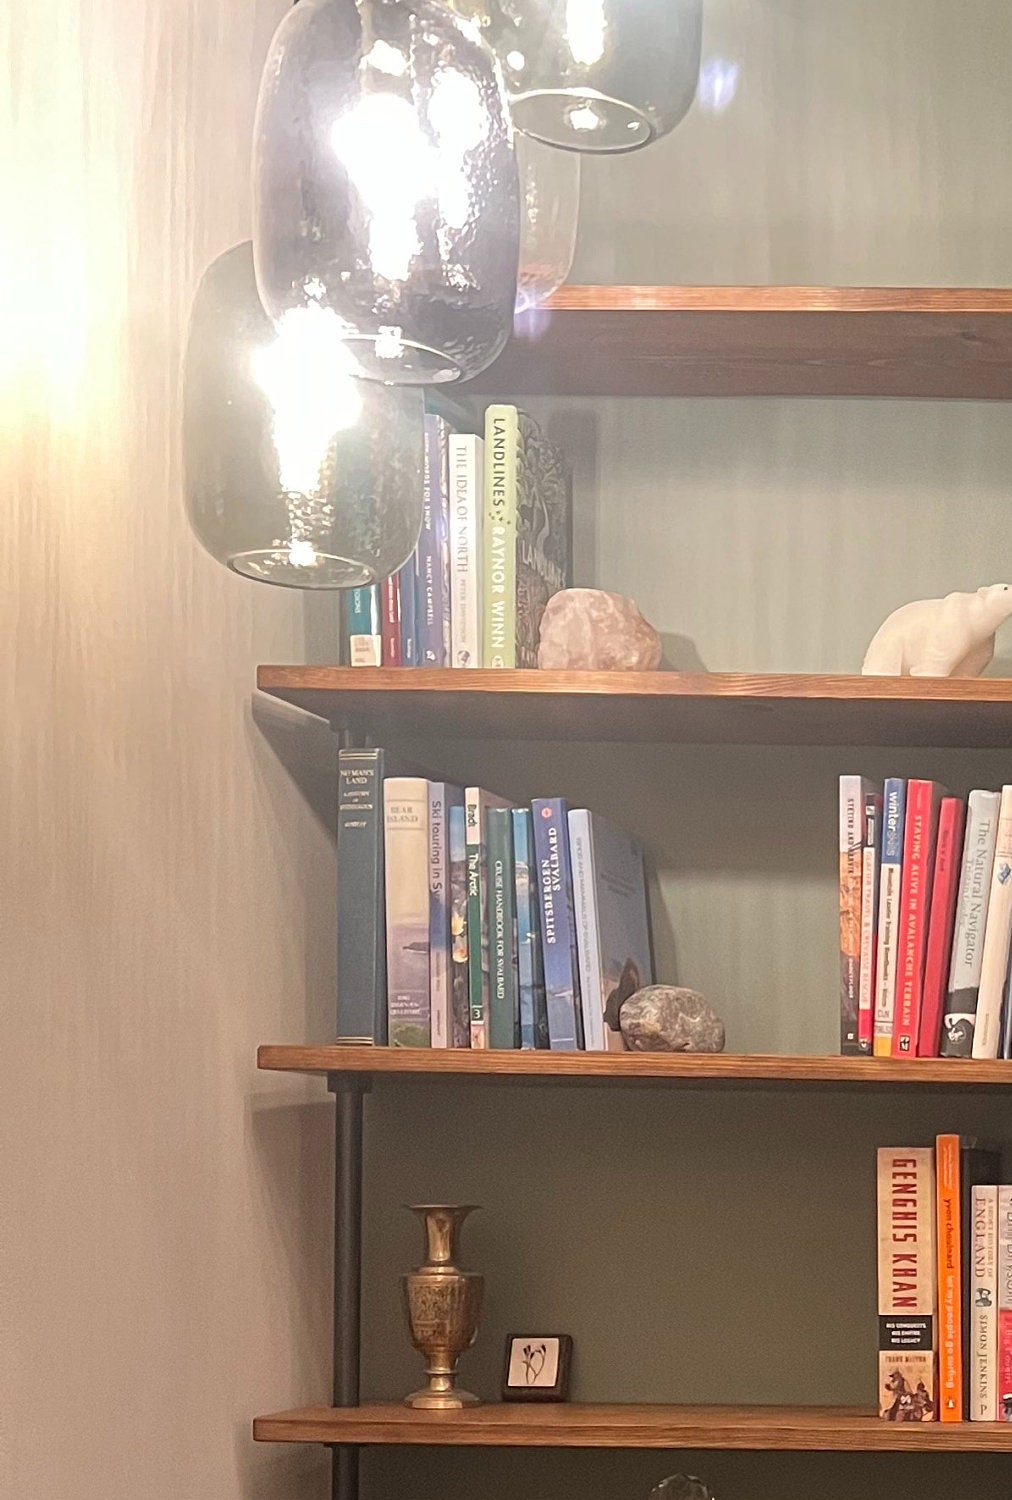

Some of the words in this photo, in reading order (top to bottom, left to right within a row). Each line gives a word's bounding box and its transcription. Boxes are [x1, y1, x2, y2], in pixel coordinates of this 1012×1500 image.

[456, 446, 467, 468] THE
[493, 418, 506, 507] LANDLINES
[456, 474, 468, 504] IDEA
[457, 505, 468, 521] OF
[457, 526, 468, 573] NORTH
[491, 526, 506, 594] RAYNOR
[491, 600, 506, 648] WINN
[346, 777, 368, 785] LAND
[387, 815, 418, 823] ISLAND
[390, 806, 413, 814] BEAR
[432, 801, 441, 818] Ski
[467, 804, 477, 828] Bradt
[431, 822, 442, 865] touring
[911, 815, 922, 859] STAYING
[978, 820, 991, 845] The
[432, 868, 443, 880] in
[469, 853, 478, 870] The
[548, 827, 561, 892] SVALBARD
[971, 849, 988, 899] Natural
[469, 871, 479, 897] Arctic
[909, 864, 919, 895] ALIVE
[495, 889, 504, 939] HANDBOOK
[541, 859, 556, 944] SPITSBERGEN
[908, 898, 917, 910] IN
[496, 940, 504, 957] FOR
[904, 913, 917, 977] AVALANCHE
[964, 903, 982, 969] Navigator
[473, 1009, 481, 1019] 3
[902, 981, 913, 1026] TERRAIN
[892, 1158, 917, 1243] GENGHIS
[975, 1198, 986, 1278] ENGLAND
[892, 1253, 918, 1308] KHAN
[979, 1314, 988, 1350] SIMON
[977, 1351, 988, 1399] JENKINS
